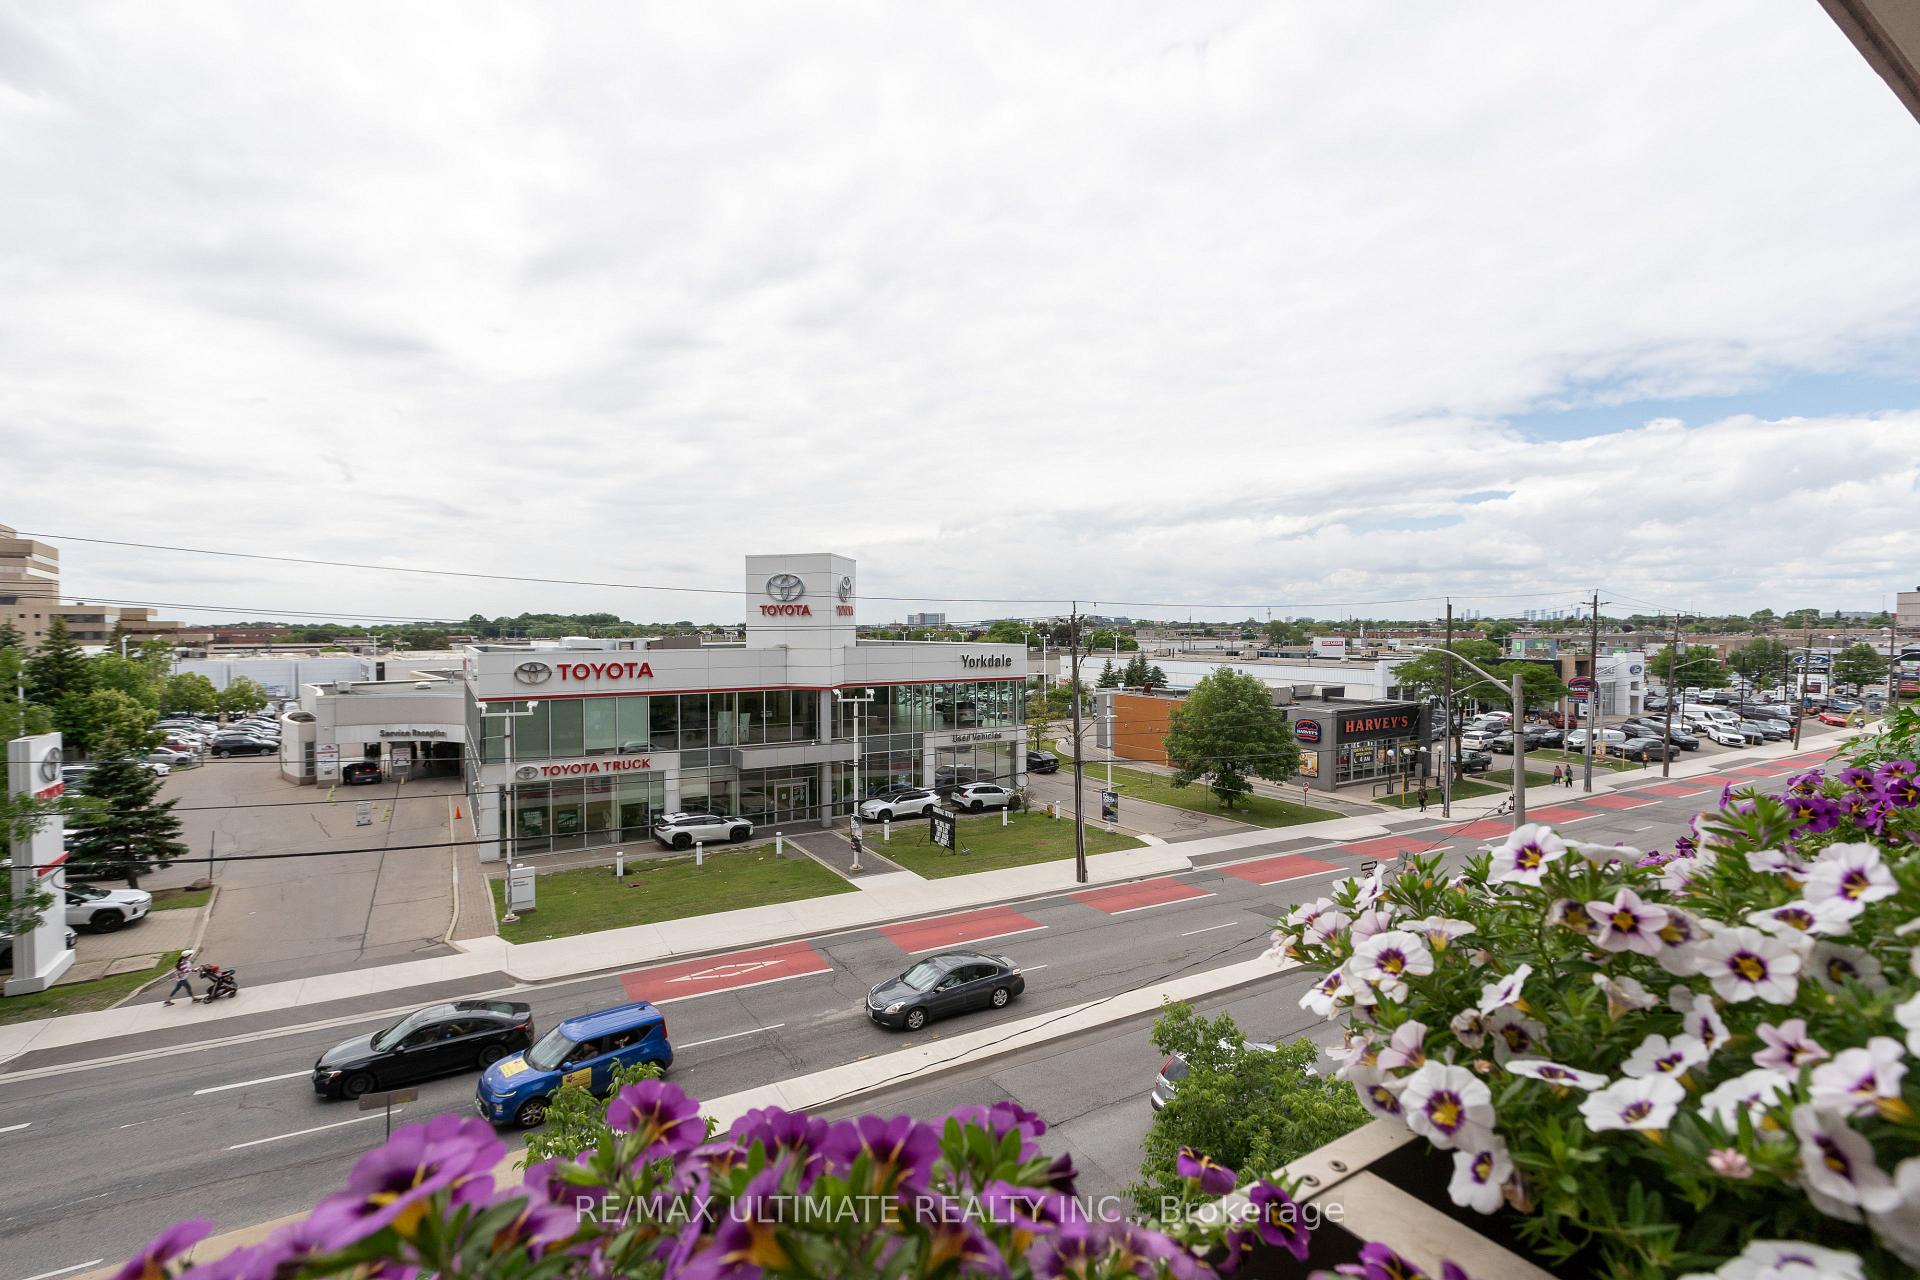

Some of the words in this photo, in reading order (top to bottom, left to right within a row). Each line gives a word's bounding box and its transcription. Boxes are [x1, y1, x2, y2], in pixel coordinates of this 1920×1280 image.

[760, 605, 811, 616] TOYOTA
[961, 654, 1012, 668] Yorkdale
[557, 662, 653, 681] TOYOTA
[1345, 715, 1409, 733] HARVEY'S
[952, 735, 970, 743] Used
[972, 732, 1002, 741] Vehicles
[541, 763, 599, 776] TOYOTA
[603, 759, 650, 772] TRUCK
